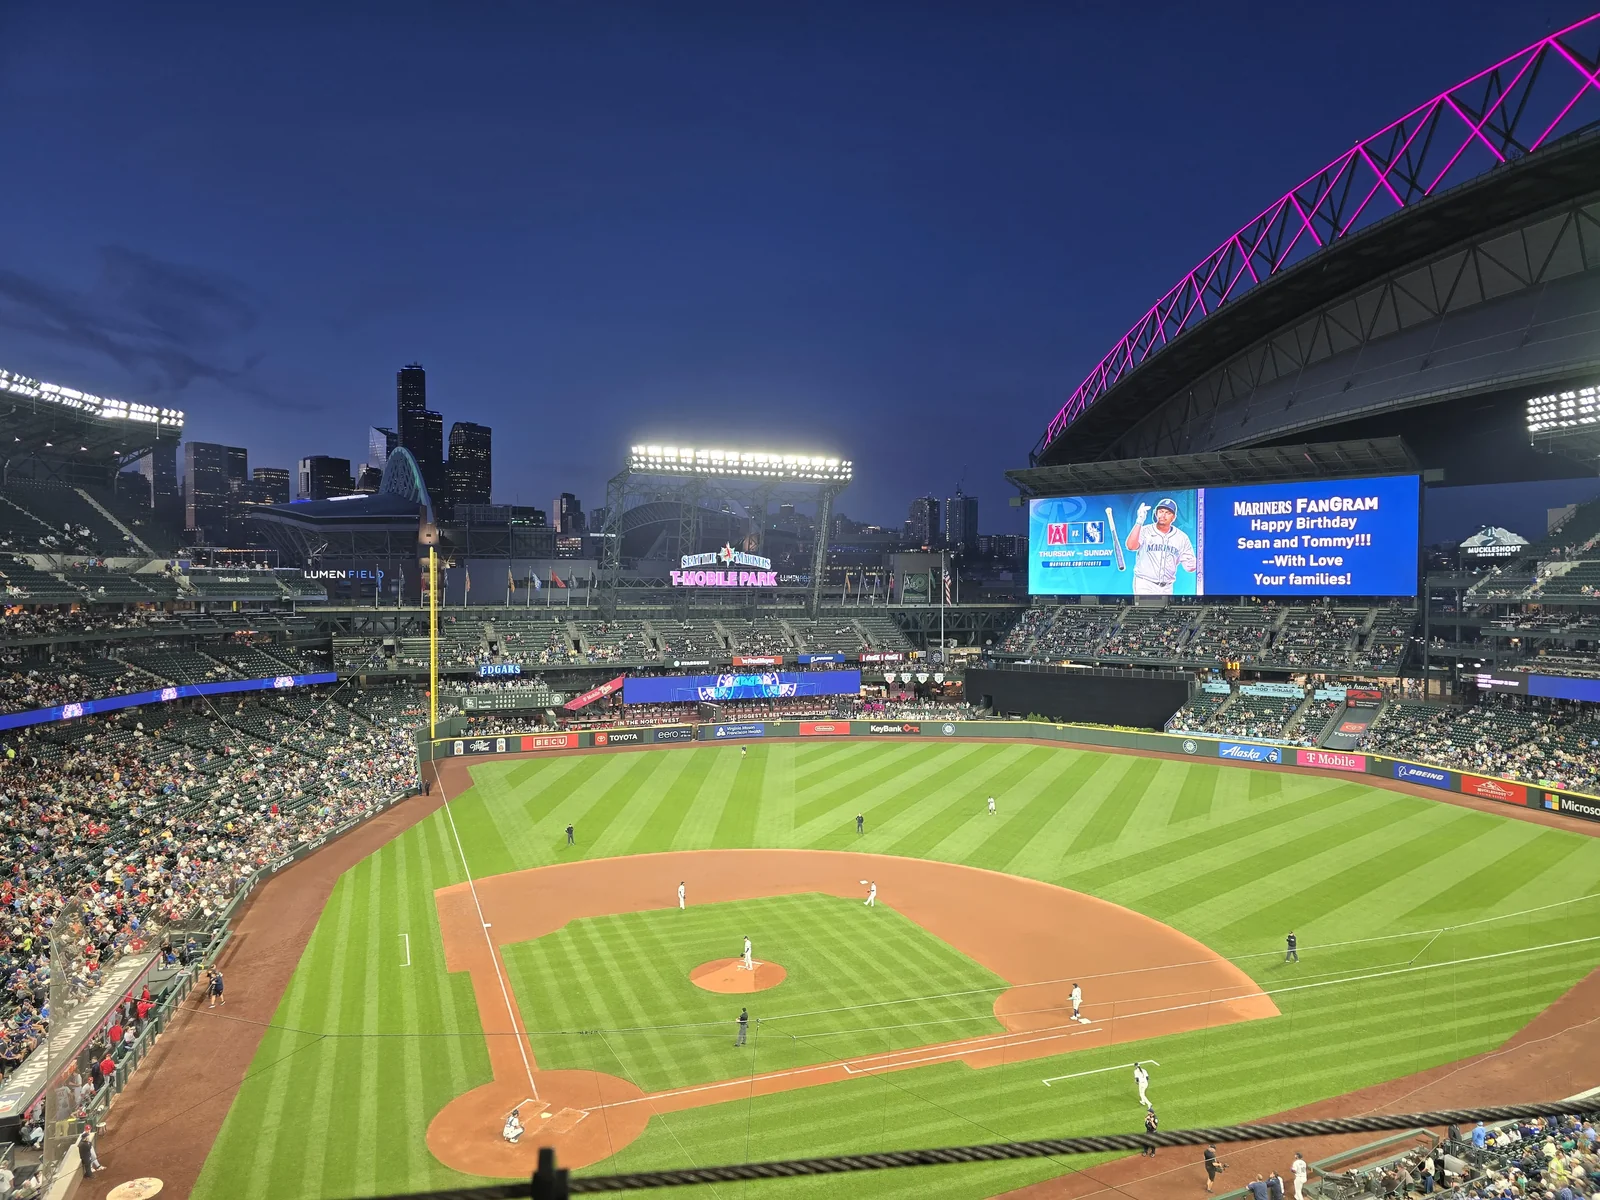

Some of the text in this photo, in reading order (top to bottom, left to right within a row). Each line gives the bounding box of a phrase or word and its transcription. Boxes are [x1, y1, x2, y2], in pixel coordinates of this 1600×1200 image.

[1234, 500, 1292, 516] MARINERS
[1251, 516, 1357, 532] Happy Birthday
[1237, 533, 1371, 549] Sean and Tommy!!!
[1038, 549, 1114, 558] THURSDAY SUNDAY
[1467, 545, 1521, 553] MUCKLESHOOT
[1262, 554, 1344, 567] --With Love
[304, 570, 384, 579] LUMEN FIELD
[670, 570, 778, 587] T-MOBILE PARK
[1253, 572, 1351, 585] Your families!
[658, 730, 679, 739] eero
[870, 725, 902, 733] KeyBank
[536, 738, 564, 746] BECU
[609, 733, 638, 742] TOYOTA
[1222, 745, 1261, 760] Alaska
[1318, 754, 1355, 767] Mobile
[1409, 768, 1444, 781] BOEING
[84, 969, 133, 1007] WELCOME
[73, 1006, 100, 1019] TO
[4, 1061, 48, 1091] PARK
